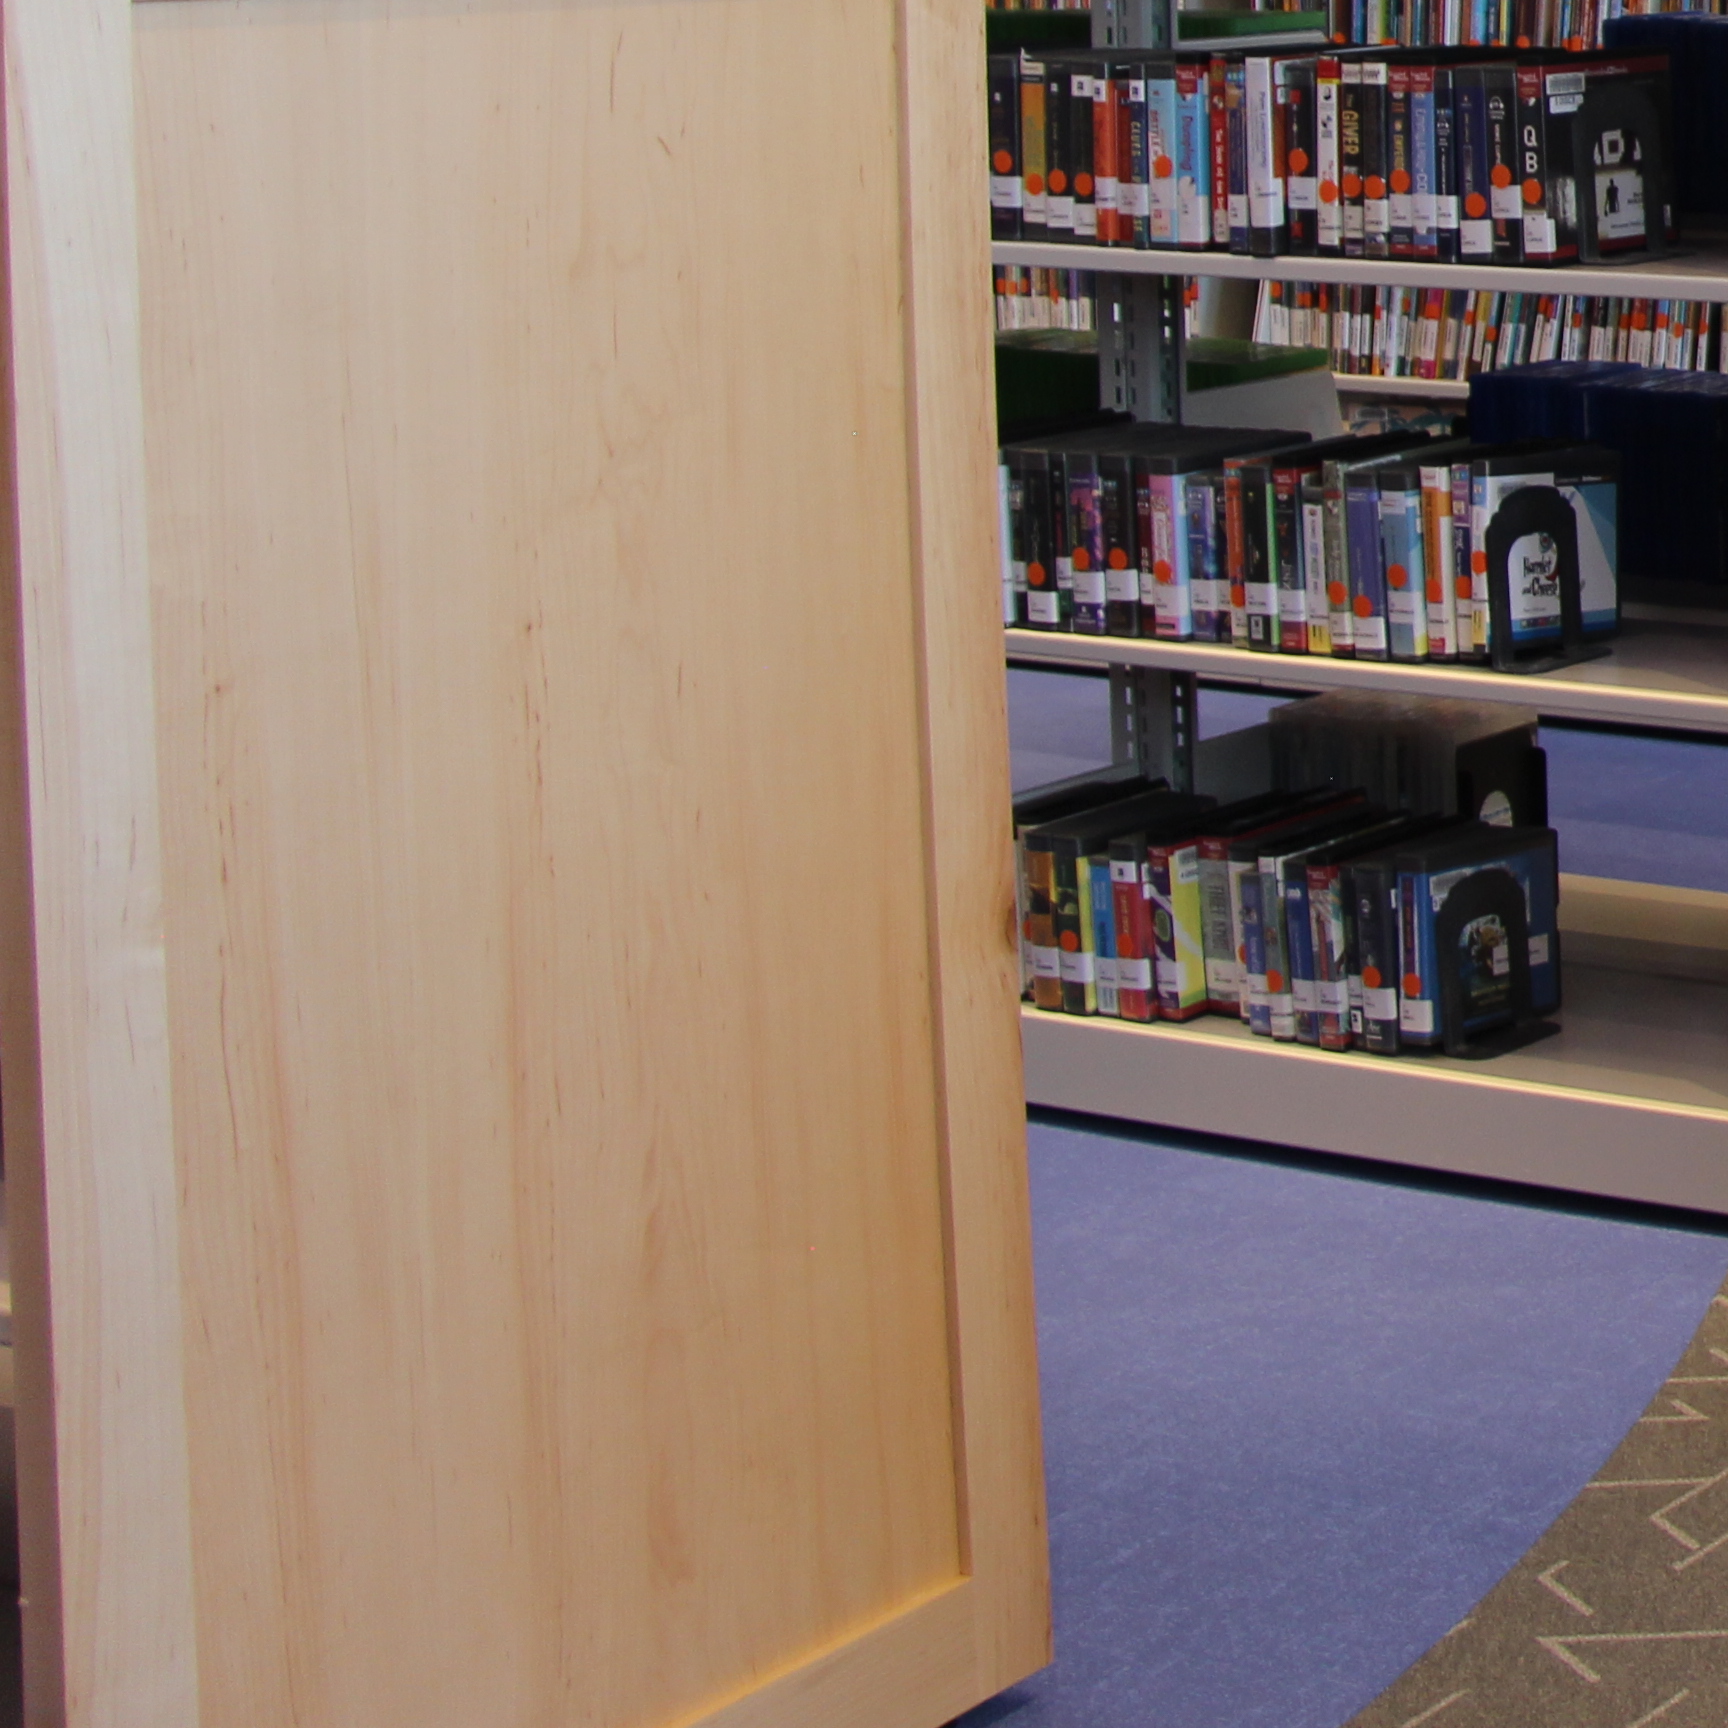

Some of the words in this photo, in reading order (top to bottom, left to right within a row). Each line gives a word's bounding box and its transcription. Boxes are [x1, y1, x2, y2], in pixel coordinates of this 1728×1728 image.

[1342, 110, 1359, 154] GIVER
[1523, 124, 1538, 148] Q
[1525, 152, 1538, 173] B
